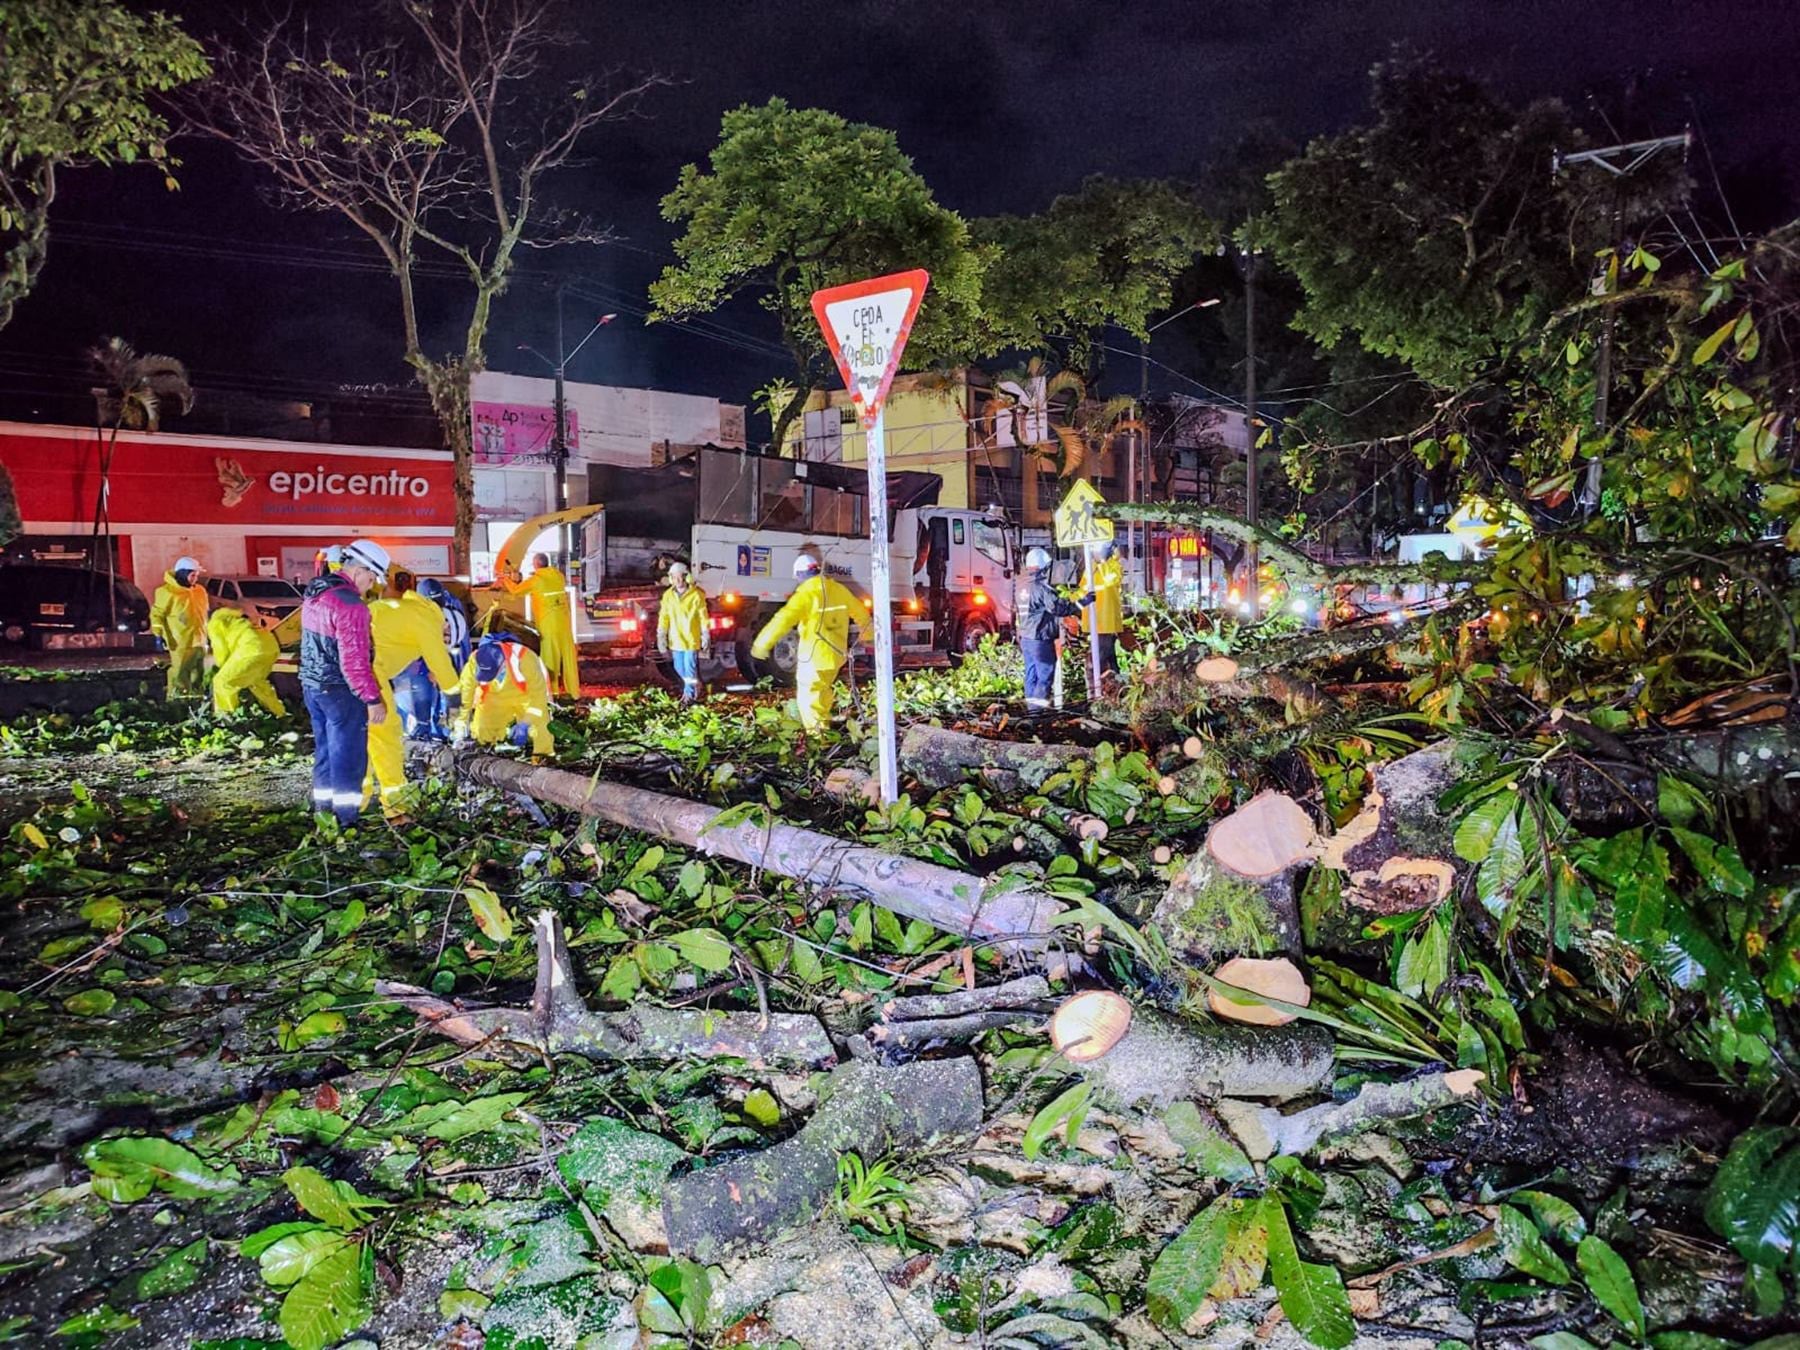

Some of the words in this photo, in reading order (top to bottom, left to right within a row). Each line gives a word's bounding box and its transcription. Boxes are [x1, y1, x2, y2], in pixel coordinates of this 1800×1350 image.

[853, 305, 883, 328] CEDA
[855, 346, 883, 368] PO
[269, 465, 429, 500] epicentro
